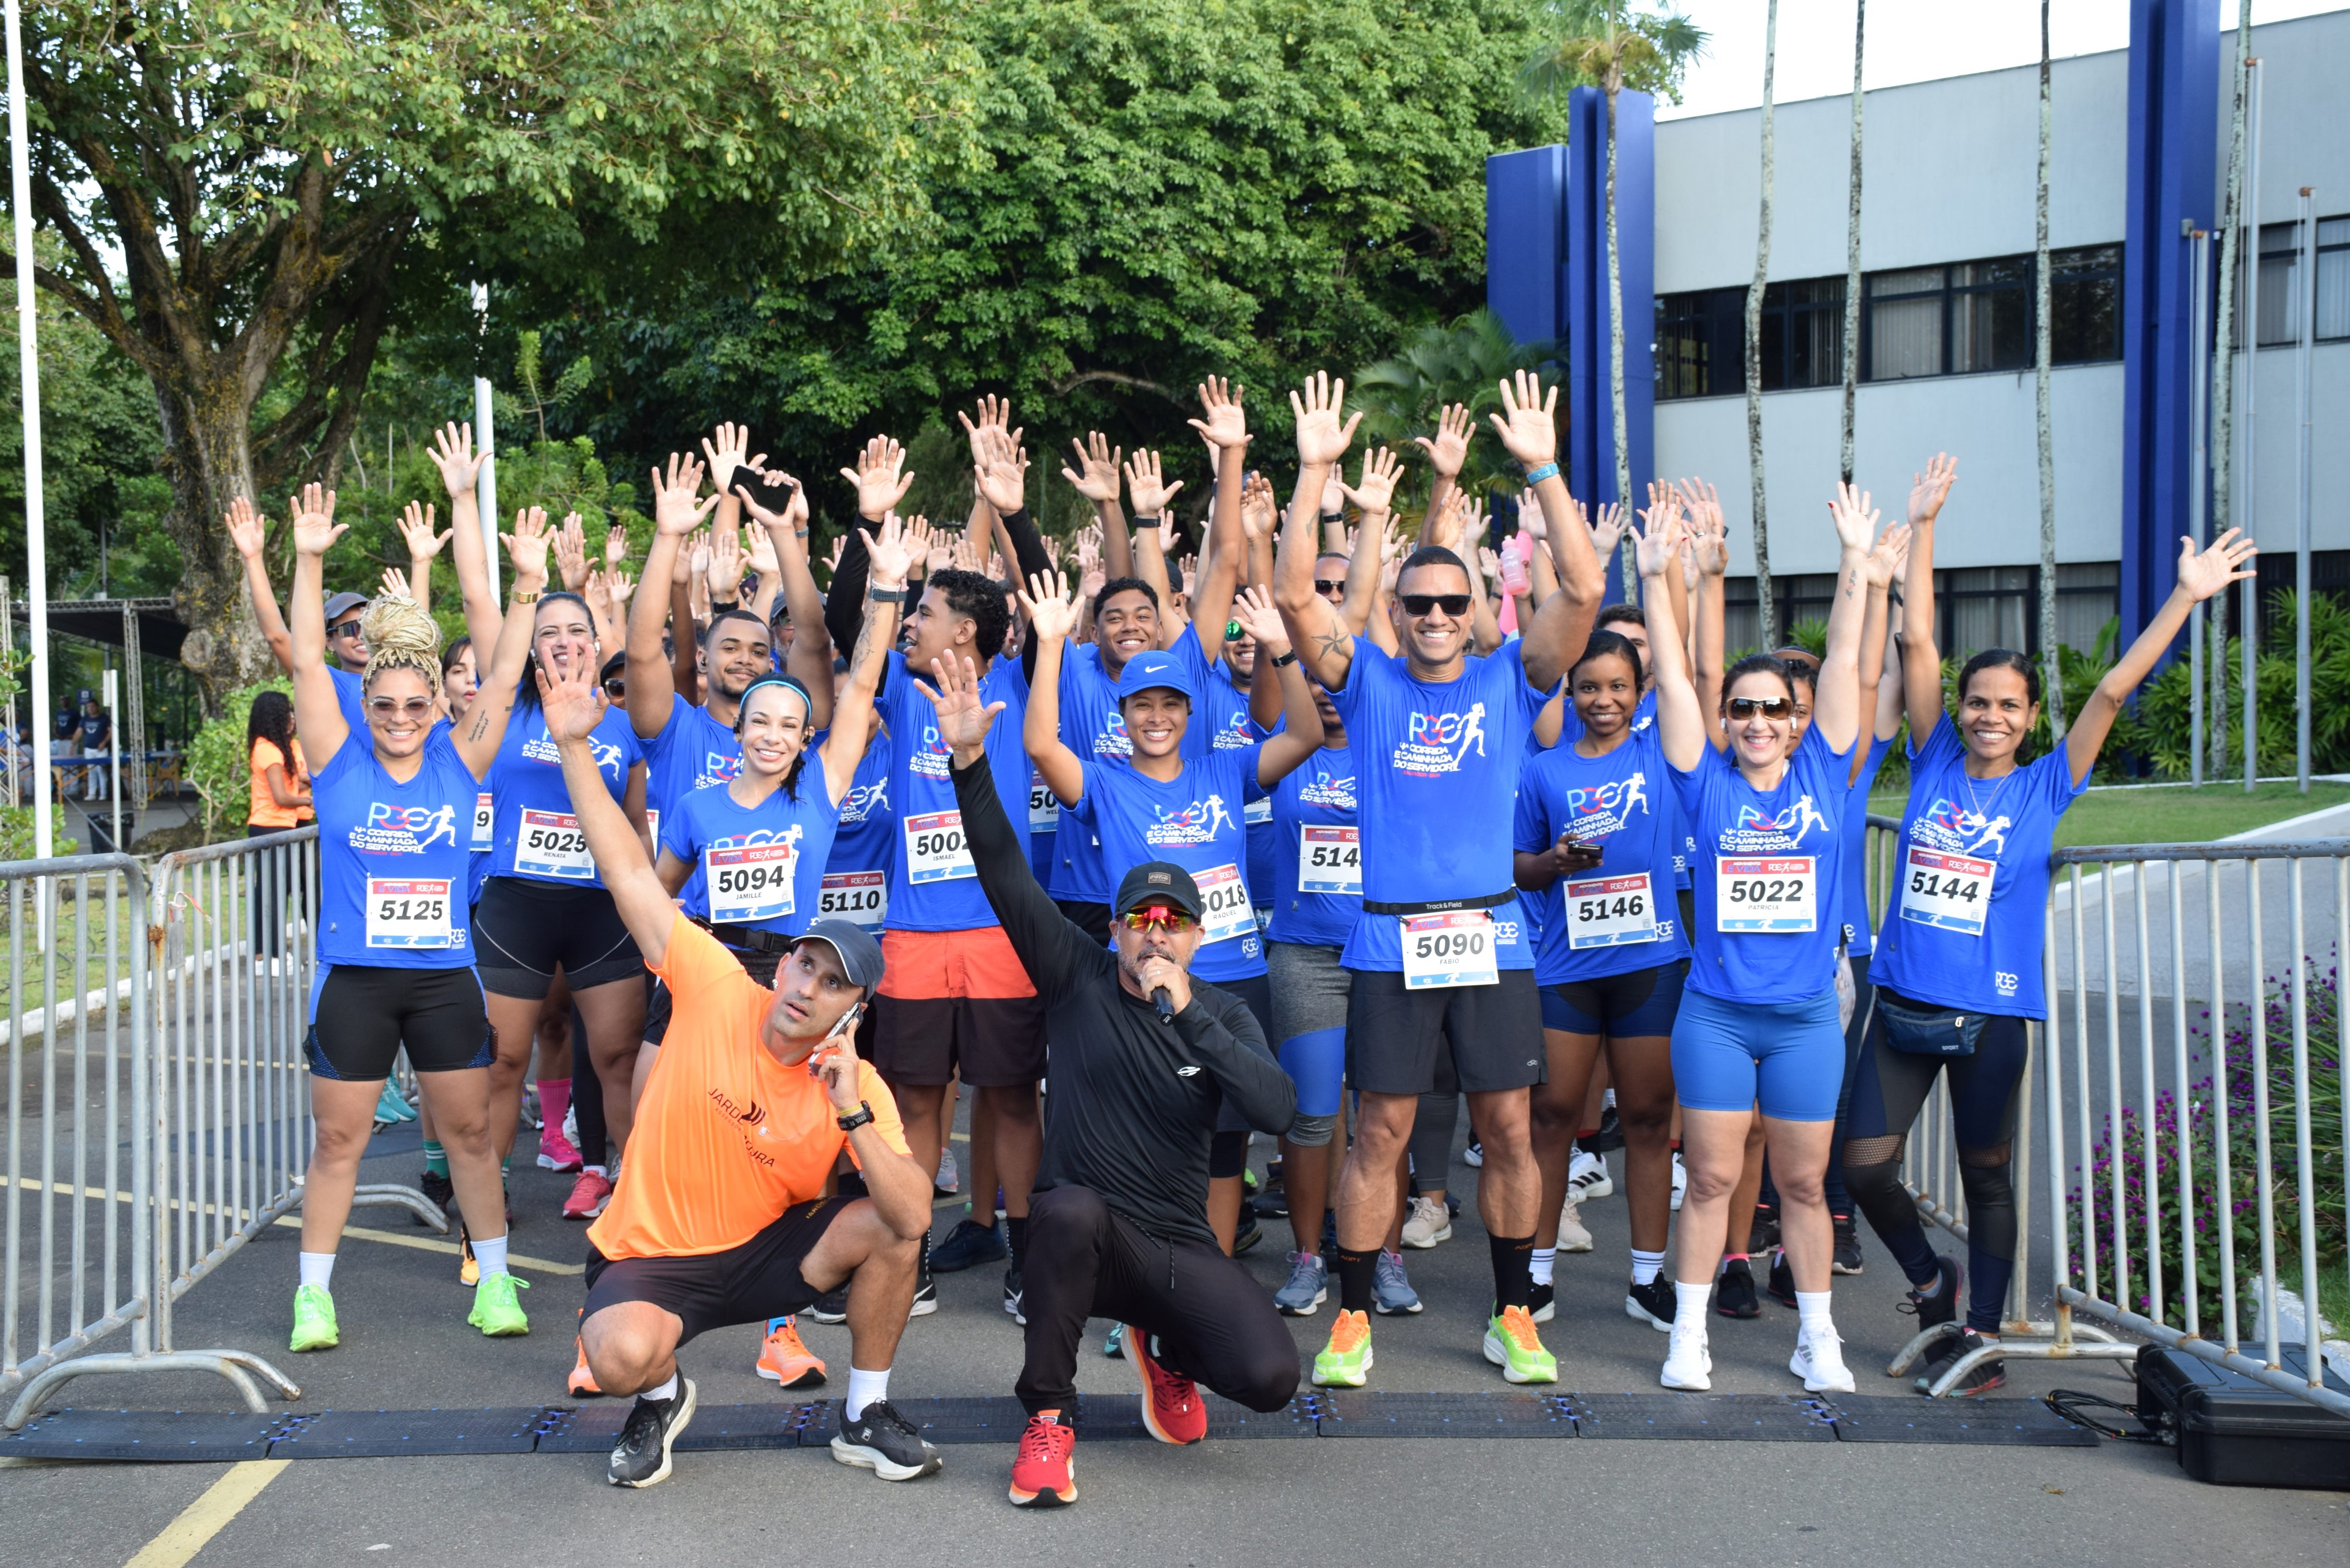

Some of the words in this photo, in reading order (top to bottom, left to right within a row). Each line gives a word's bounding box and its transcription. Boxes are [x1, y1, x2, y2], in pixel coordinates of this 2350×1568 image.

[1394, 750, 1401, 758] E
[1401, 751, 1453, 763] CAMINHADA
[1410, 744, 1448, 755] CORRIDA
[537, 753, 562, 764] SERV
[1393, 759, 1407, 768] DO
[1407, 762, 1453, 772] SERVIDOR
[909, 764, 922, 772] DO
[1566, 782, 1621, 818] PGE
[1573, 810, 1612, 826] CORRIDA
[356, 833, 418, 845] CAMINHADA
[367, 828, 414, 838] CORRIDA
[528, 829, 586, 853] 5025
[1727, 835, 1791, 844] CAMINHADA
[365, 841, 419, 852] SERVIDOR
[1736, 843, 1792, 851] SERVIDOR
[1311, 847, 1361, 867] 514
[718, 866, 784, 893] 5094
[1910, 871, 1979, 903] 5144
[1730, 880, 1803, 902] 5022
[821, 890, 880, 913] 5110
[1200, 884, 1245, 915] 5018
[379, 900, 443, 920] 5125
[1213, 909, 1236, 920] RAQUEL
[1579, 895, 1643, 922] 5146
[1416, 932, 1484, 958] 5090
